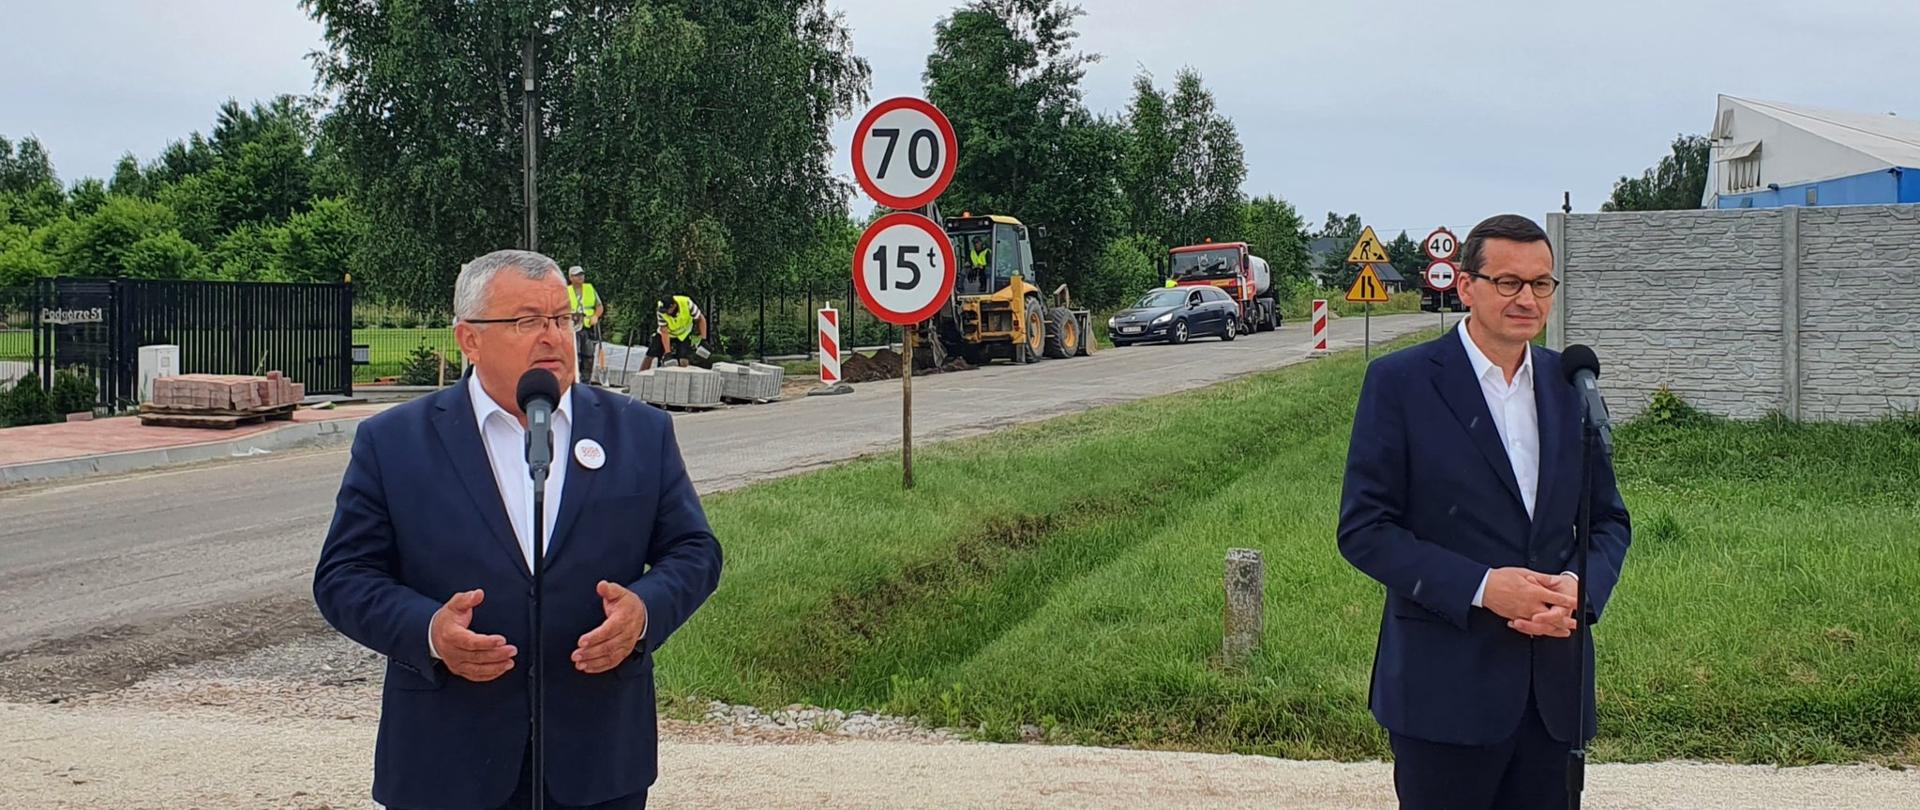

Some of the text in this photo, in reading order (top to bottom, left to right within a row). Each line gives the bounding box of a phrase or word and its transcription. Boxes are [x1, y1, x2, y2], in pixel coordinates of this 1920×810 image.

[872, 128, 939, 179] 70
[1430, 238, 1453, 253] 40
[91, 307, 103, 321] 51
